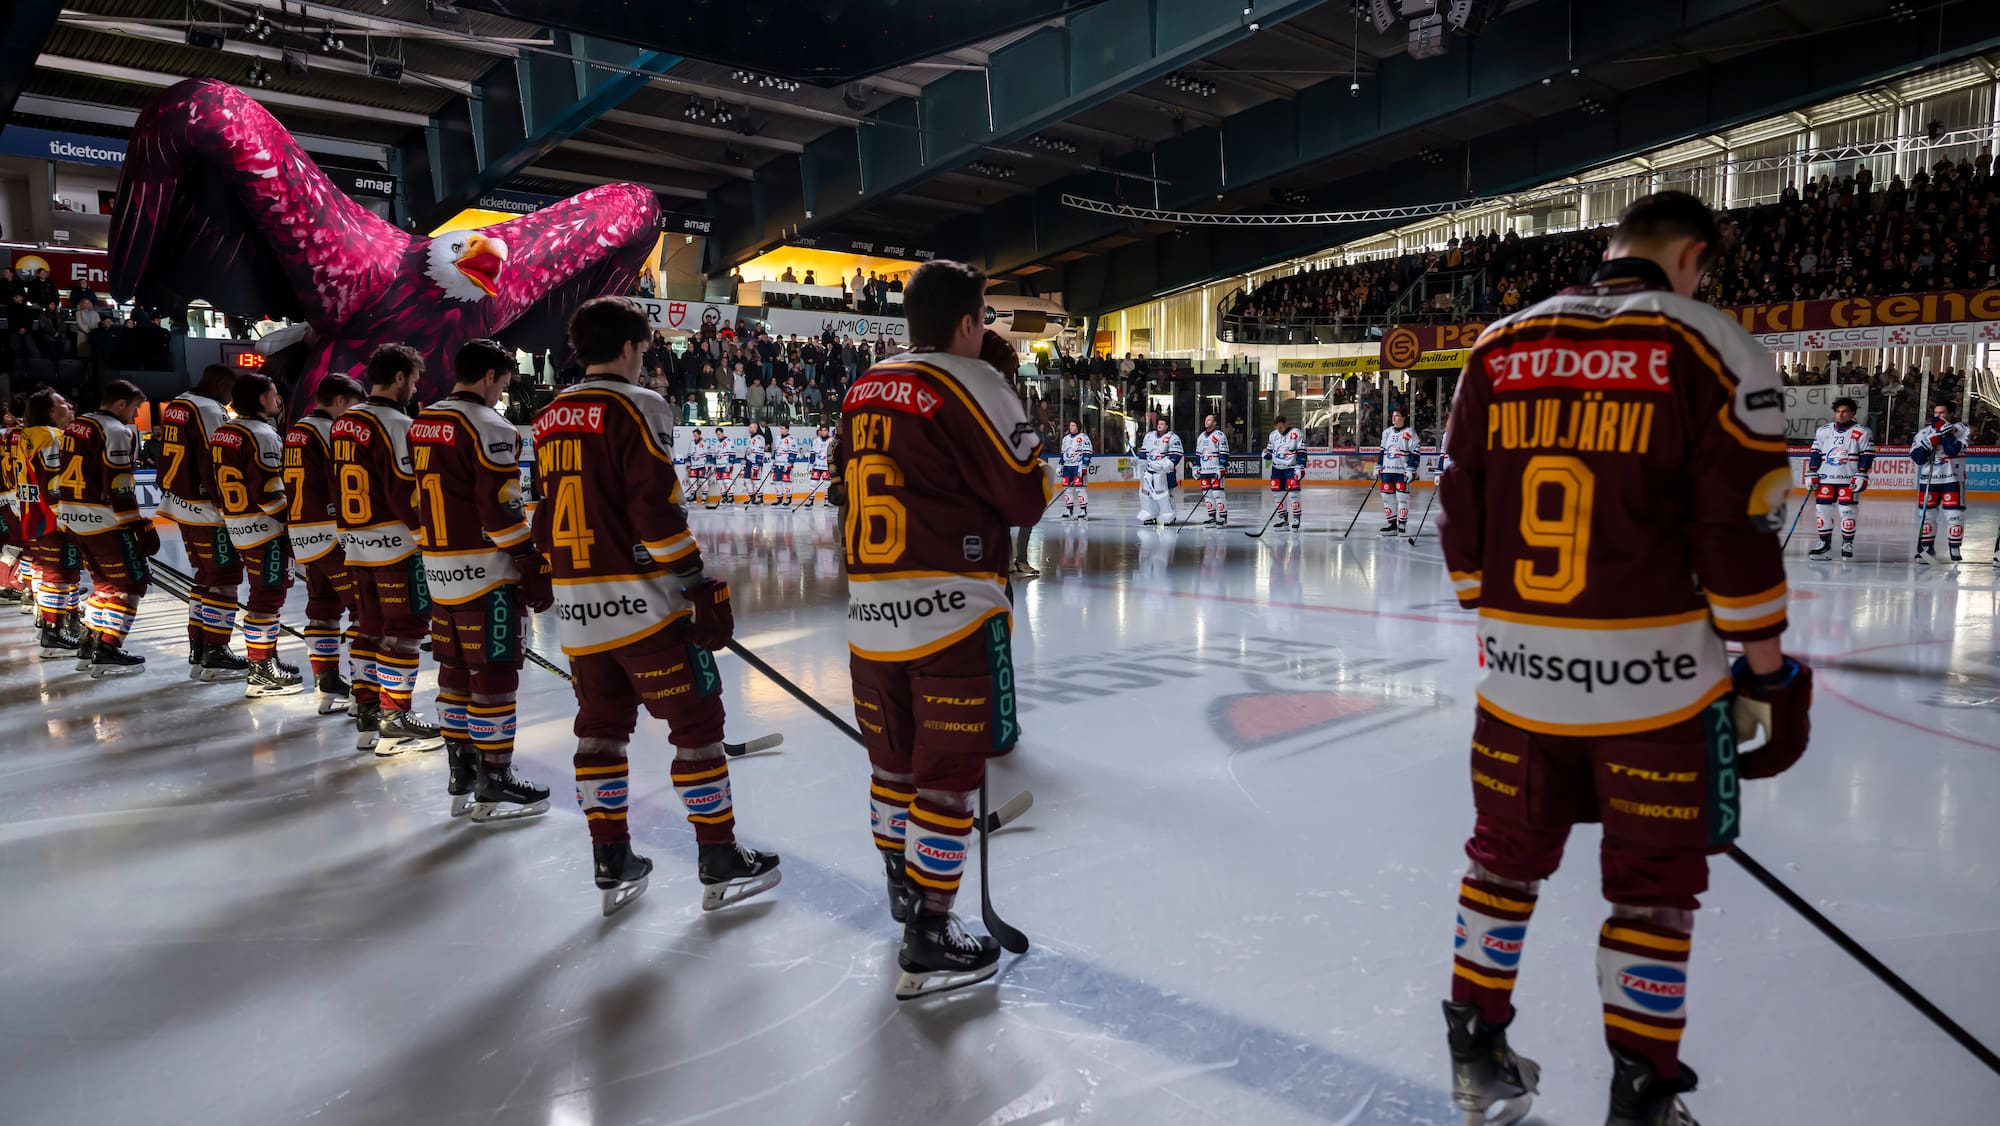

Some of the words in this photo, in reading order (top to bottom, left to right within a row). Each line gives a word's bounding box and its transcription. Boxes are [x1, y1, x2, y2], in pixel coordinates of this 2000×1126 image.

[355, 178, 393, 194] amag
[683, 219, 711, 233] amag
[851, 240, 874, 253] amag
[883, 245, 905, 257] amag
[914, 248, 936, 260] amag
[1828, 328, 1878, 342] CGC
[1914, 324, 1969, 337] CGC
[1913, 336, 1968, 345] ENERGIE
[849, 381, 913, 406] TUDOR
[1487, 391, 1656, 455] PULJUJÄRVI
[162, 442, 186, 490] 7
[283, 467, 305, 521] 7
[1513, 454, 1596, 605] 9
[848, 589, 967, 628] wissquote
[1485, 636, 1698, 693] Swissquote
[922, 695, 987, 706] TRUE
[1605, 761, 1700, 783] TRUE
